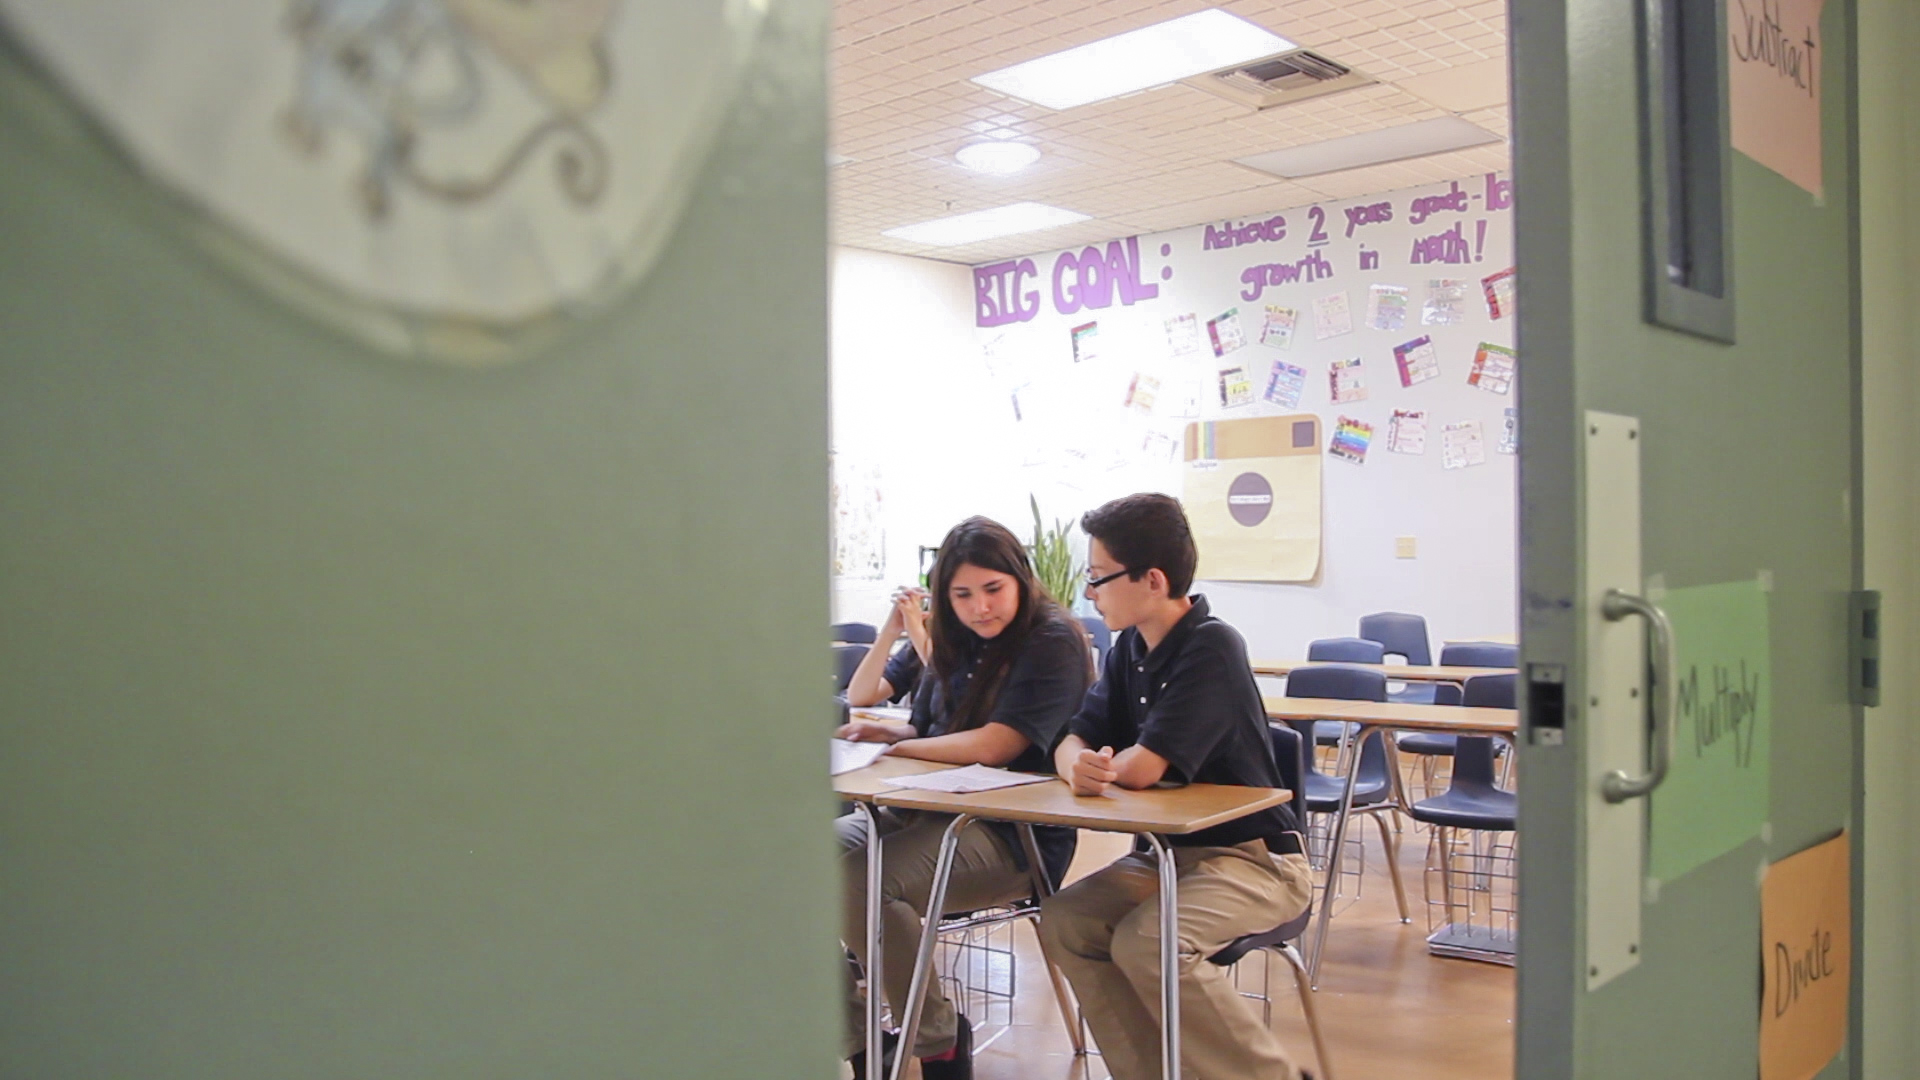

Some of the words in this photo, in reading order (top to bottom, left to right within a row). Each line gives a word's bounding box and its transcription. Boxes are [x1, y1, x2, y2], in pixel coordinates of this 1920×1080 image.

[1203, 216, 1286, 250] Achieve
[1307, 206, 1330, 242] 2
[1344, 201, 1393, 238] years
[973, 258, 1040, 328] BIG
[1052, 235, 1173, 315] GOAL:
[1240, 249, 1334, 302] growth
[1359, 243, 1379, 270] in
[1680, 658, 1759, 768] Multiply
